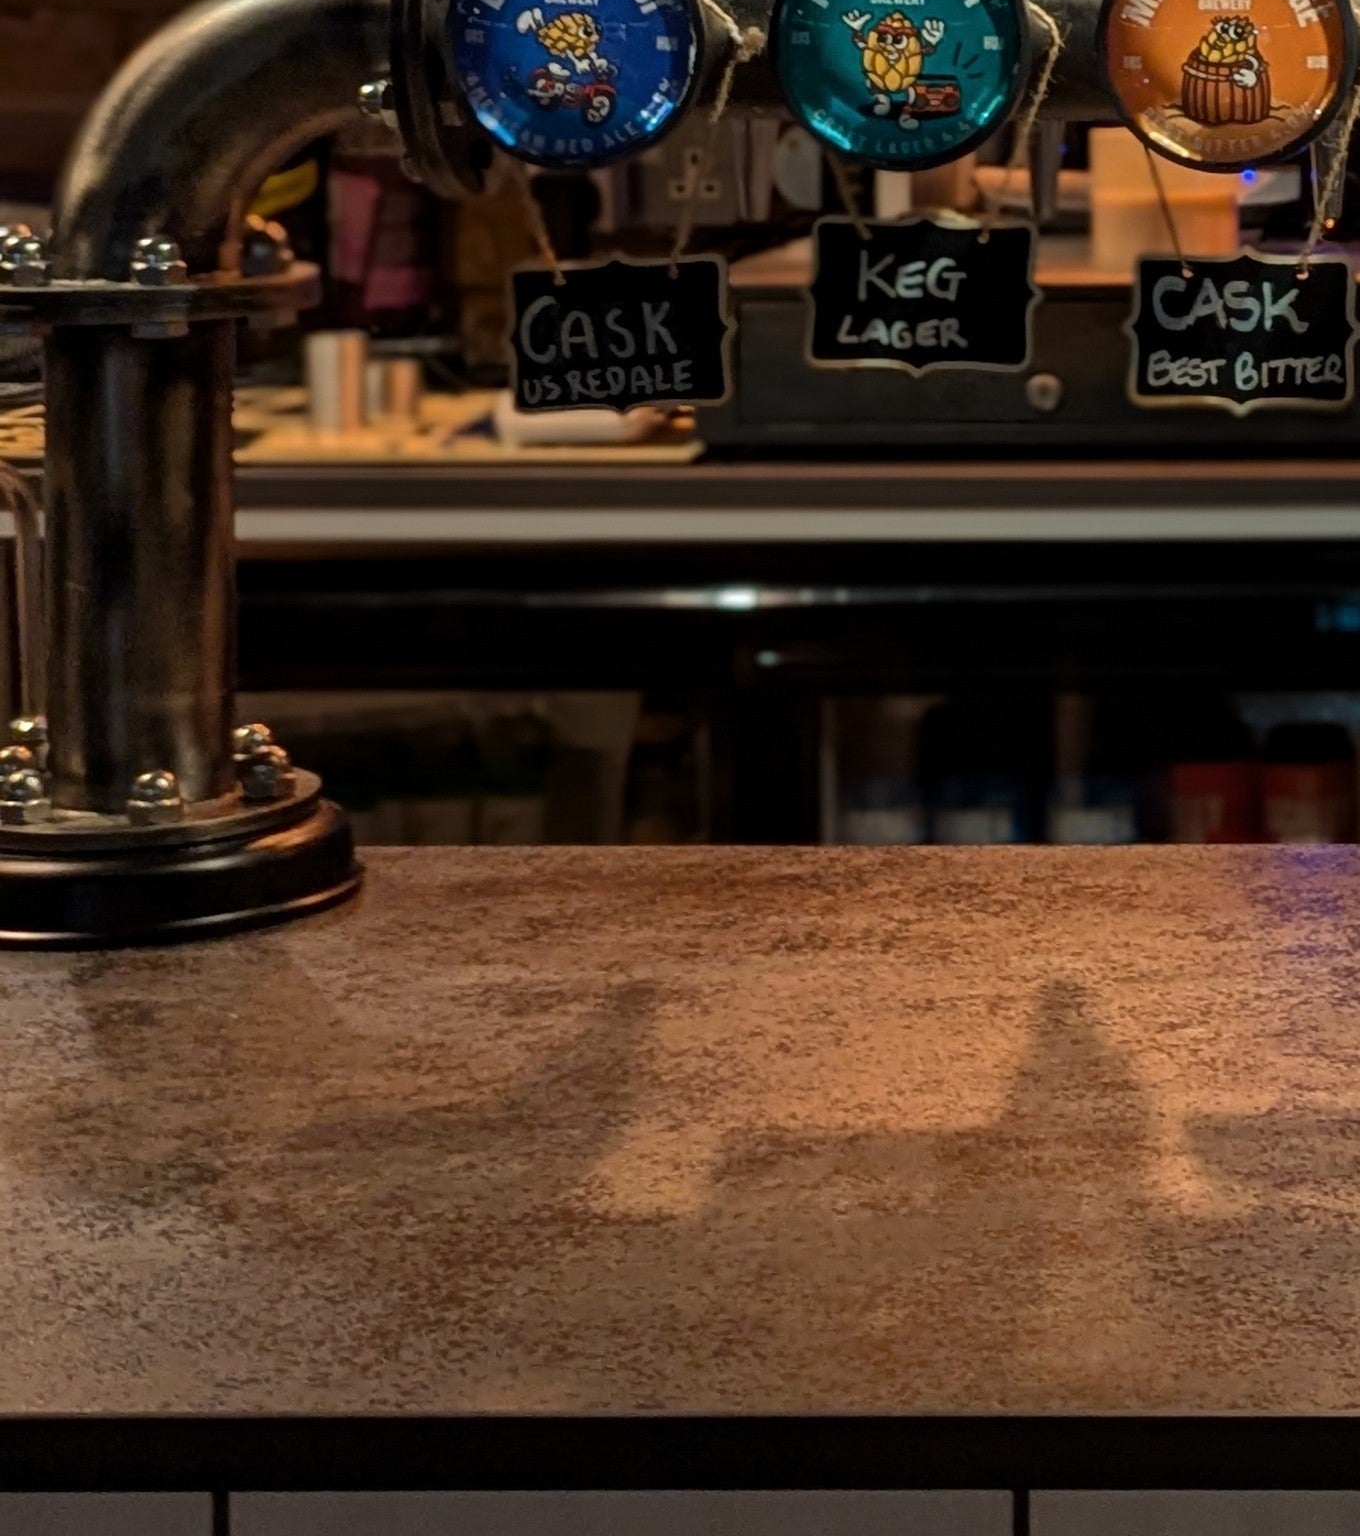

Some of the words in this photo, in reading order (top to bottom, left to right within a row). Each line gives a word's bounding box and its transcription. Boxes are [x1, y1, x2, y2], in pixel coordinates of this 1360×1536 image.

[858, 249, 968, 302] KEG
[520, 295, 678, 364] CASK
[837, 315, 969, 350] LAGER
[1152, 275, 1310, 334] CASK
